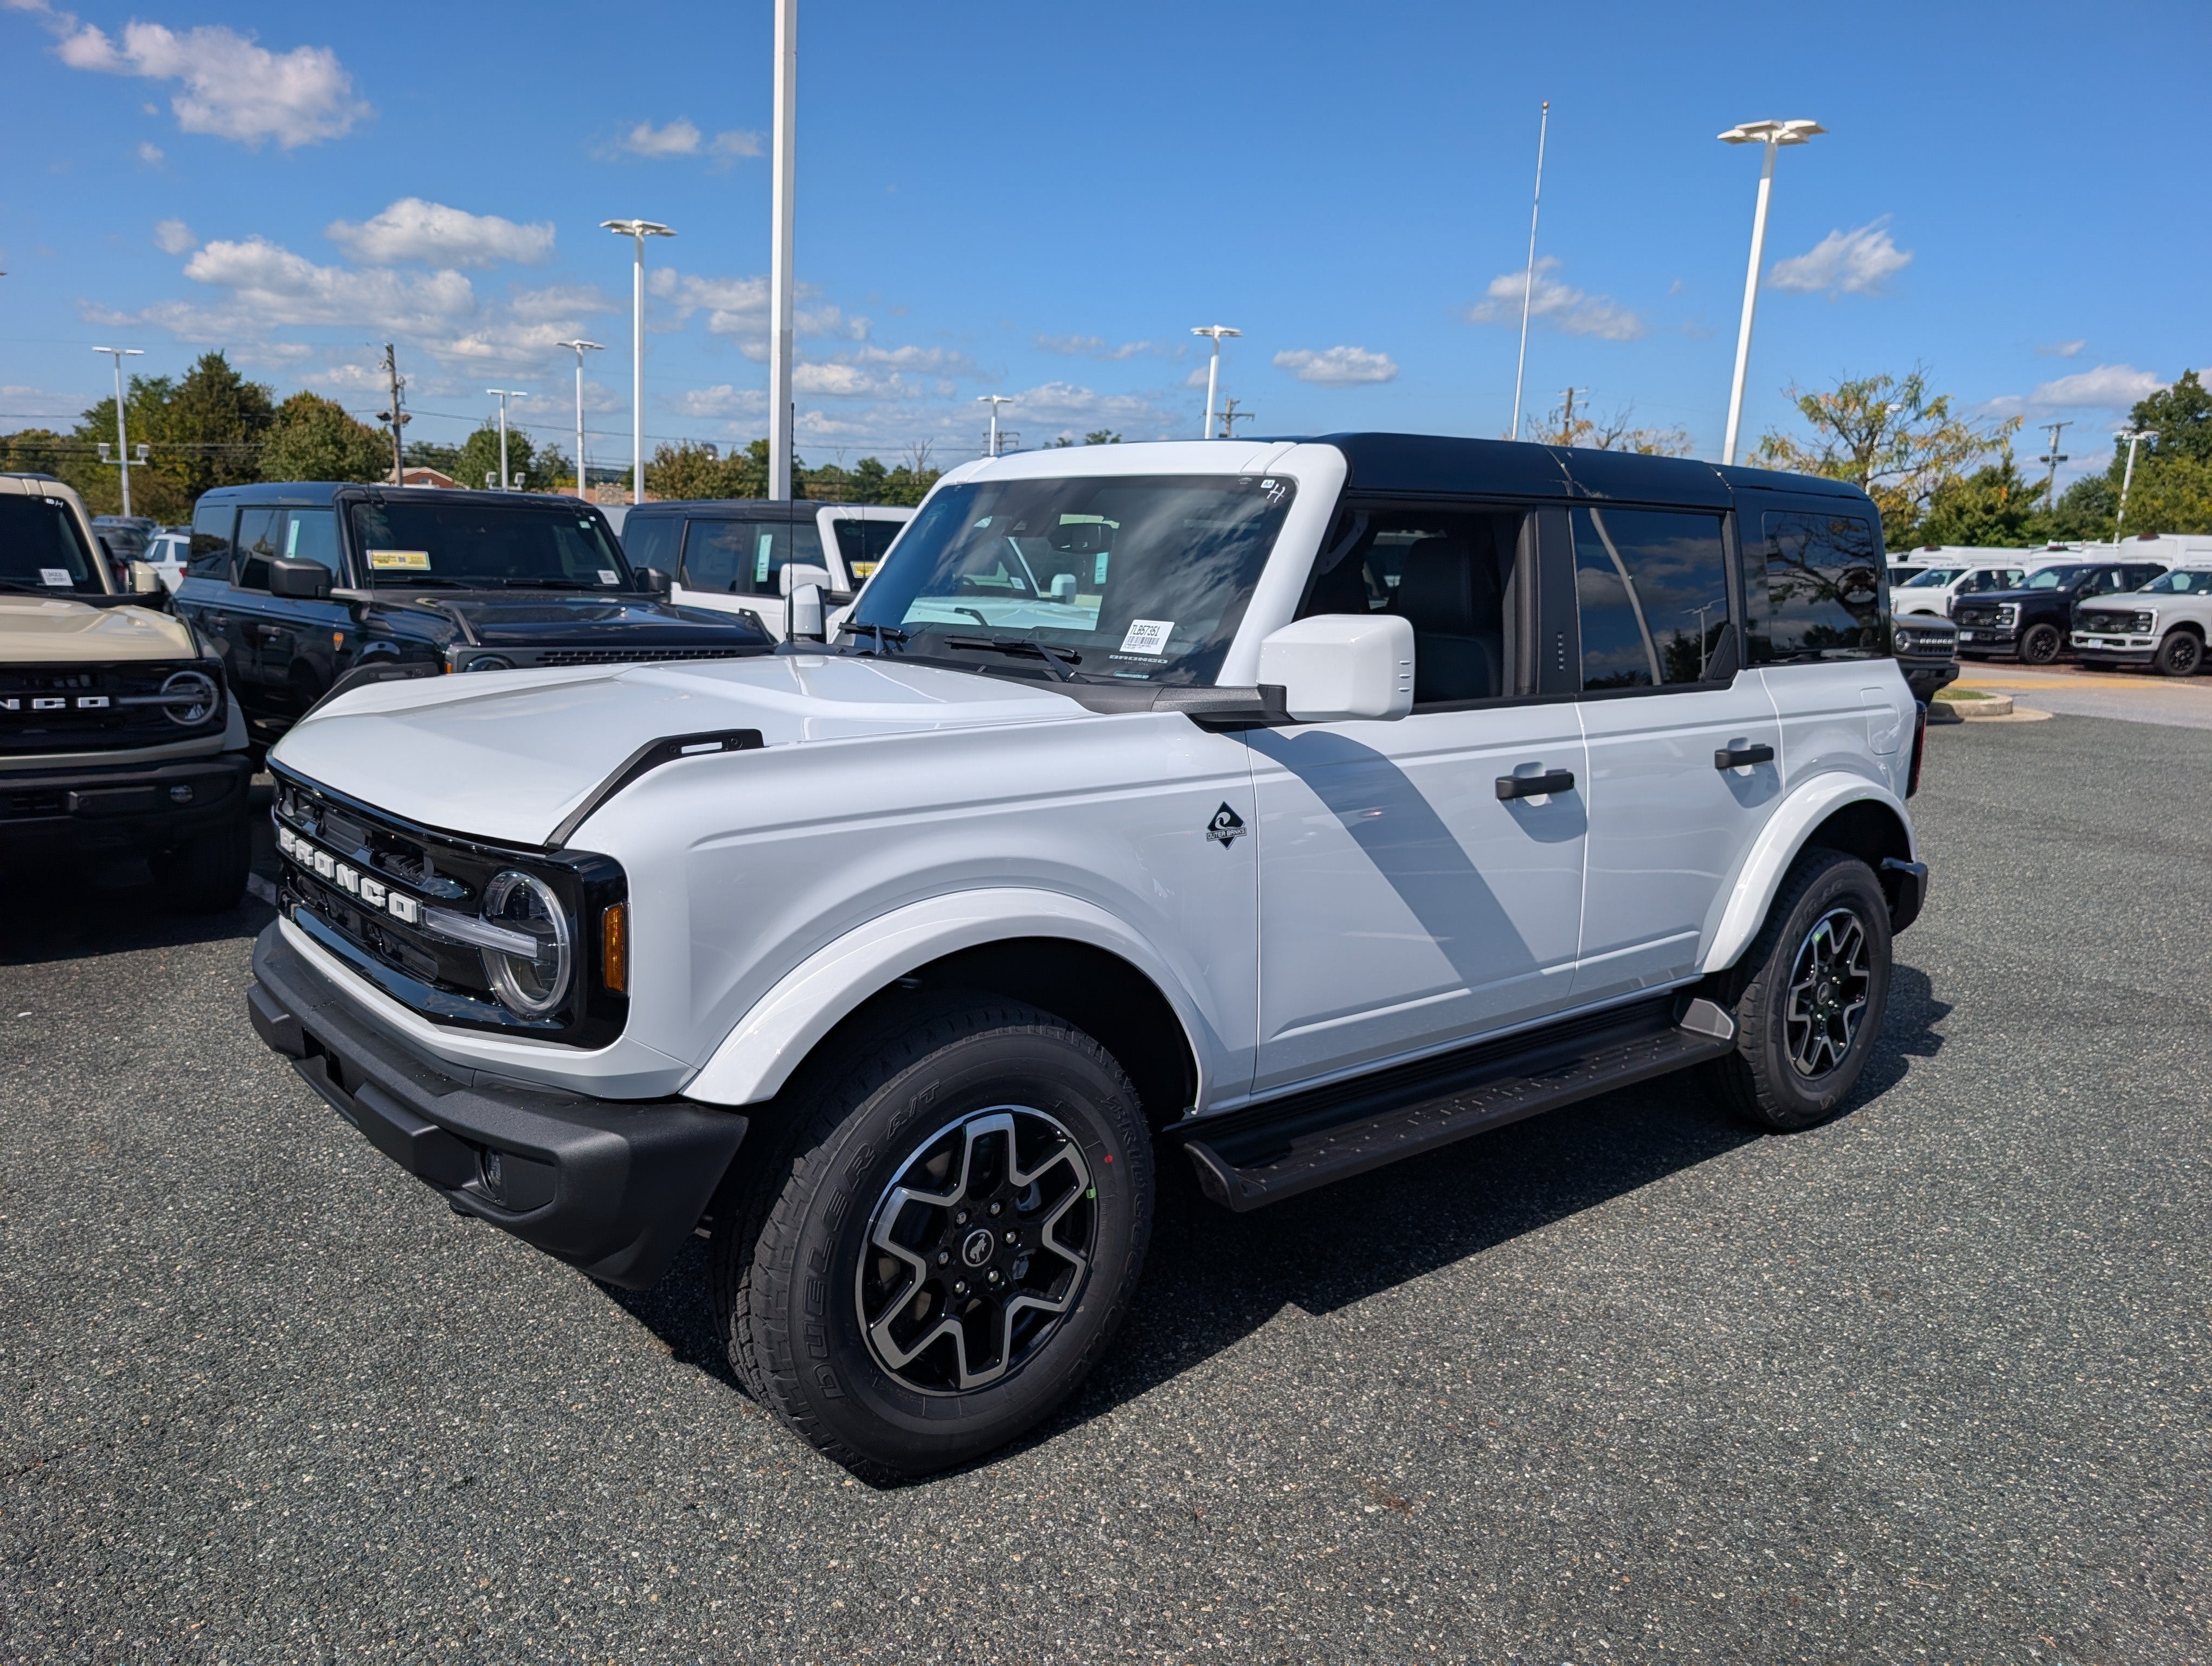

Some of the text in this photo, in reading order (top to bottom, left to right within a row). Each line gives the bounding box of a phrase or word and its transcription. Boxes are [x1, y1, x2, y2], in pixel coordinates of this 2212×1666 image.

[1266, 483, 1285, 503] H
[1129, 624, 1161, 637] TLB57351
[1109, 655, 1168, 664] BRONCO
[1207, 828, 1245, 839] OUTER BANKS
[280, 827, 417, 923] BRONCO
[803, 1080, 940, 1399] DUELER A/T
